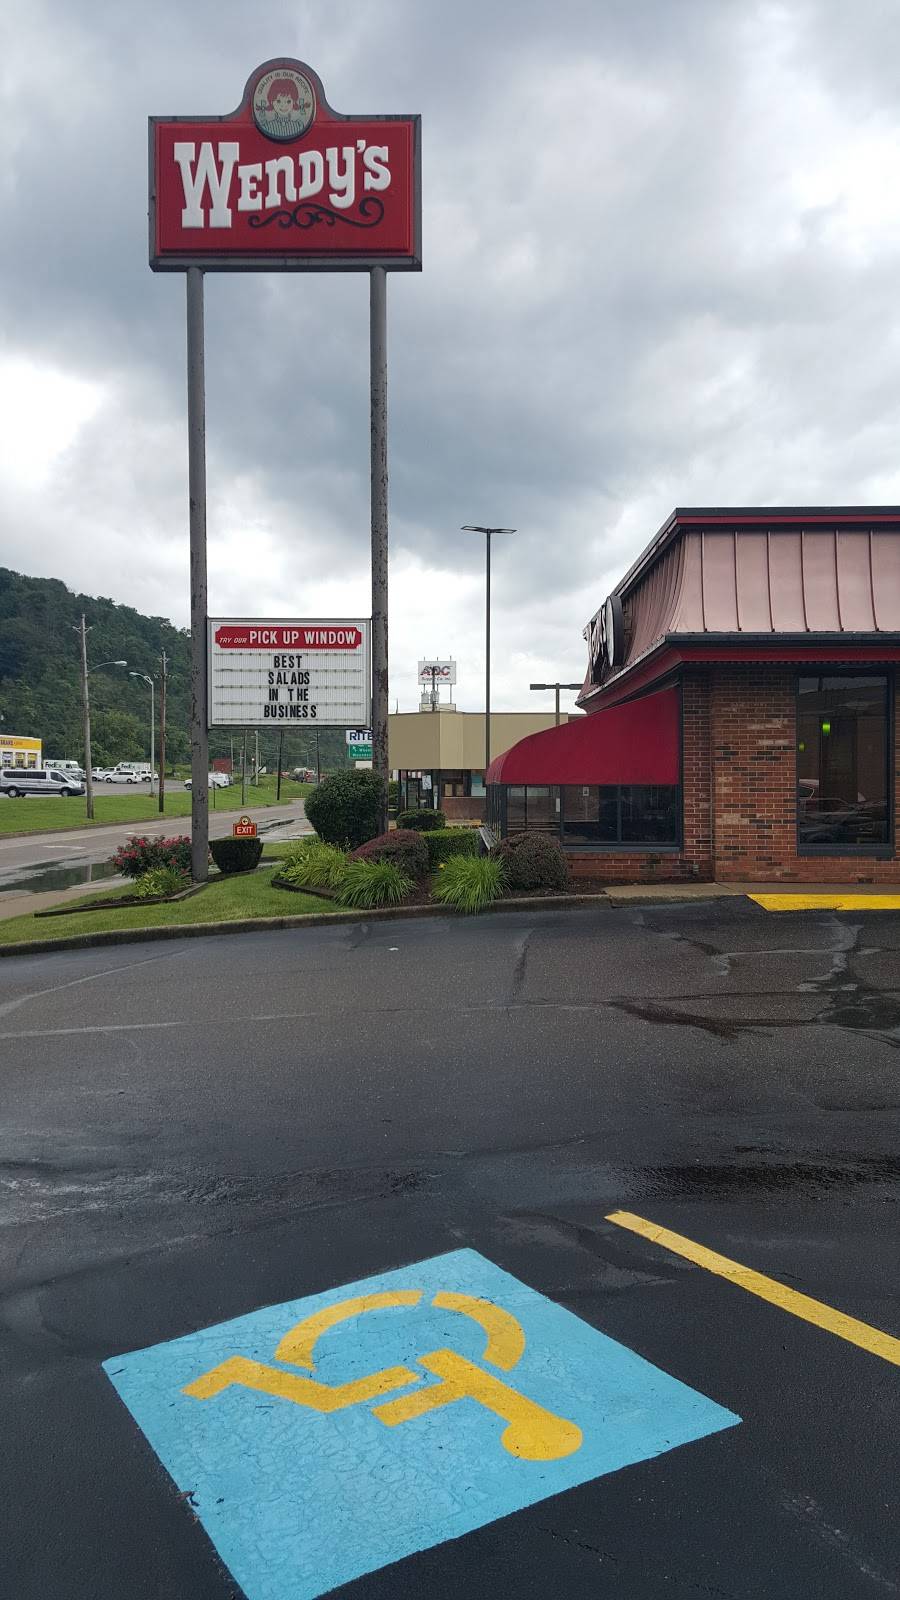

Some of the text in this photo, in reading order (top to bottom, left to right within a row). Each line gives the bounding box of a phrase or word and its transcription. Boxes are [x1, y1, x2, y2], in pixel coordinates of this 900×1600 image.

[174, 140, 391, 228] Wendy's
[250, 631, 277, 644] PICK
[283, 631, 299, 644] UP
[304, 631, 356, 644] WINDOW
[274, 655, 302, 668] BEST
[268, 672, 310, 684] SALADS
[269, 688, 309, 701] IN THE
[264, 705, 317, 718] BUSINESS
[349, 731, 373, 740] RITE
[236, 826, 253, 834] EXIT
